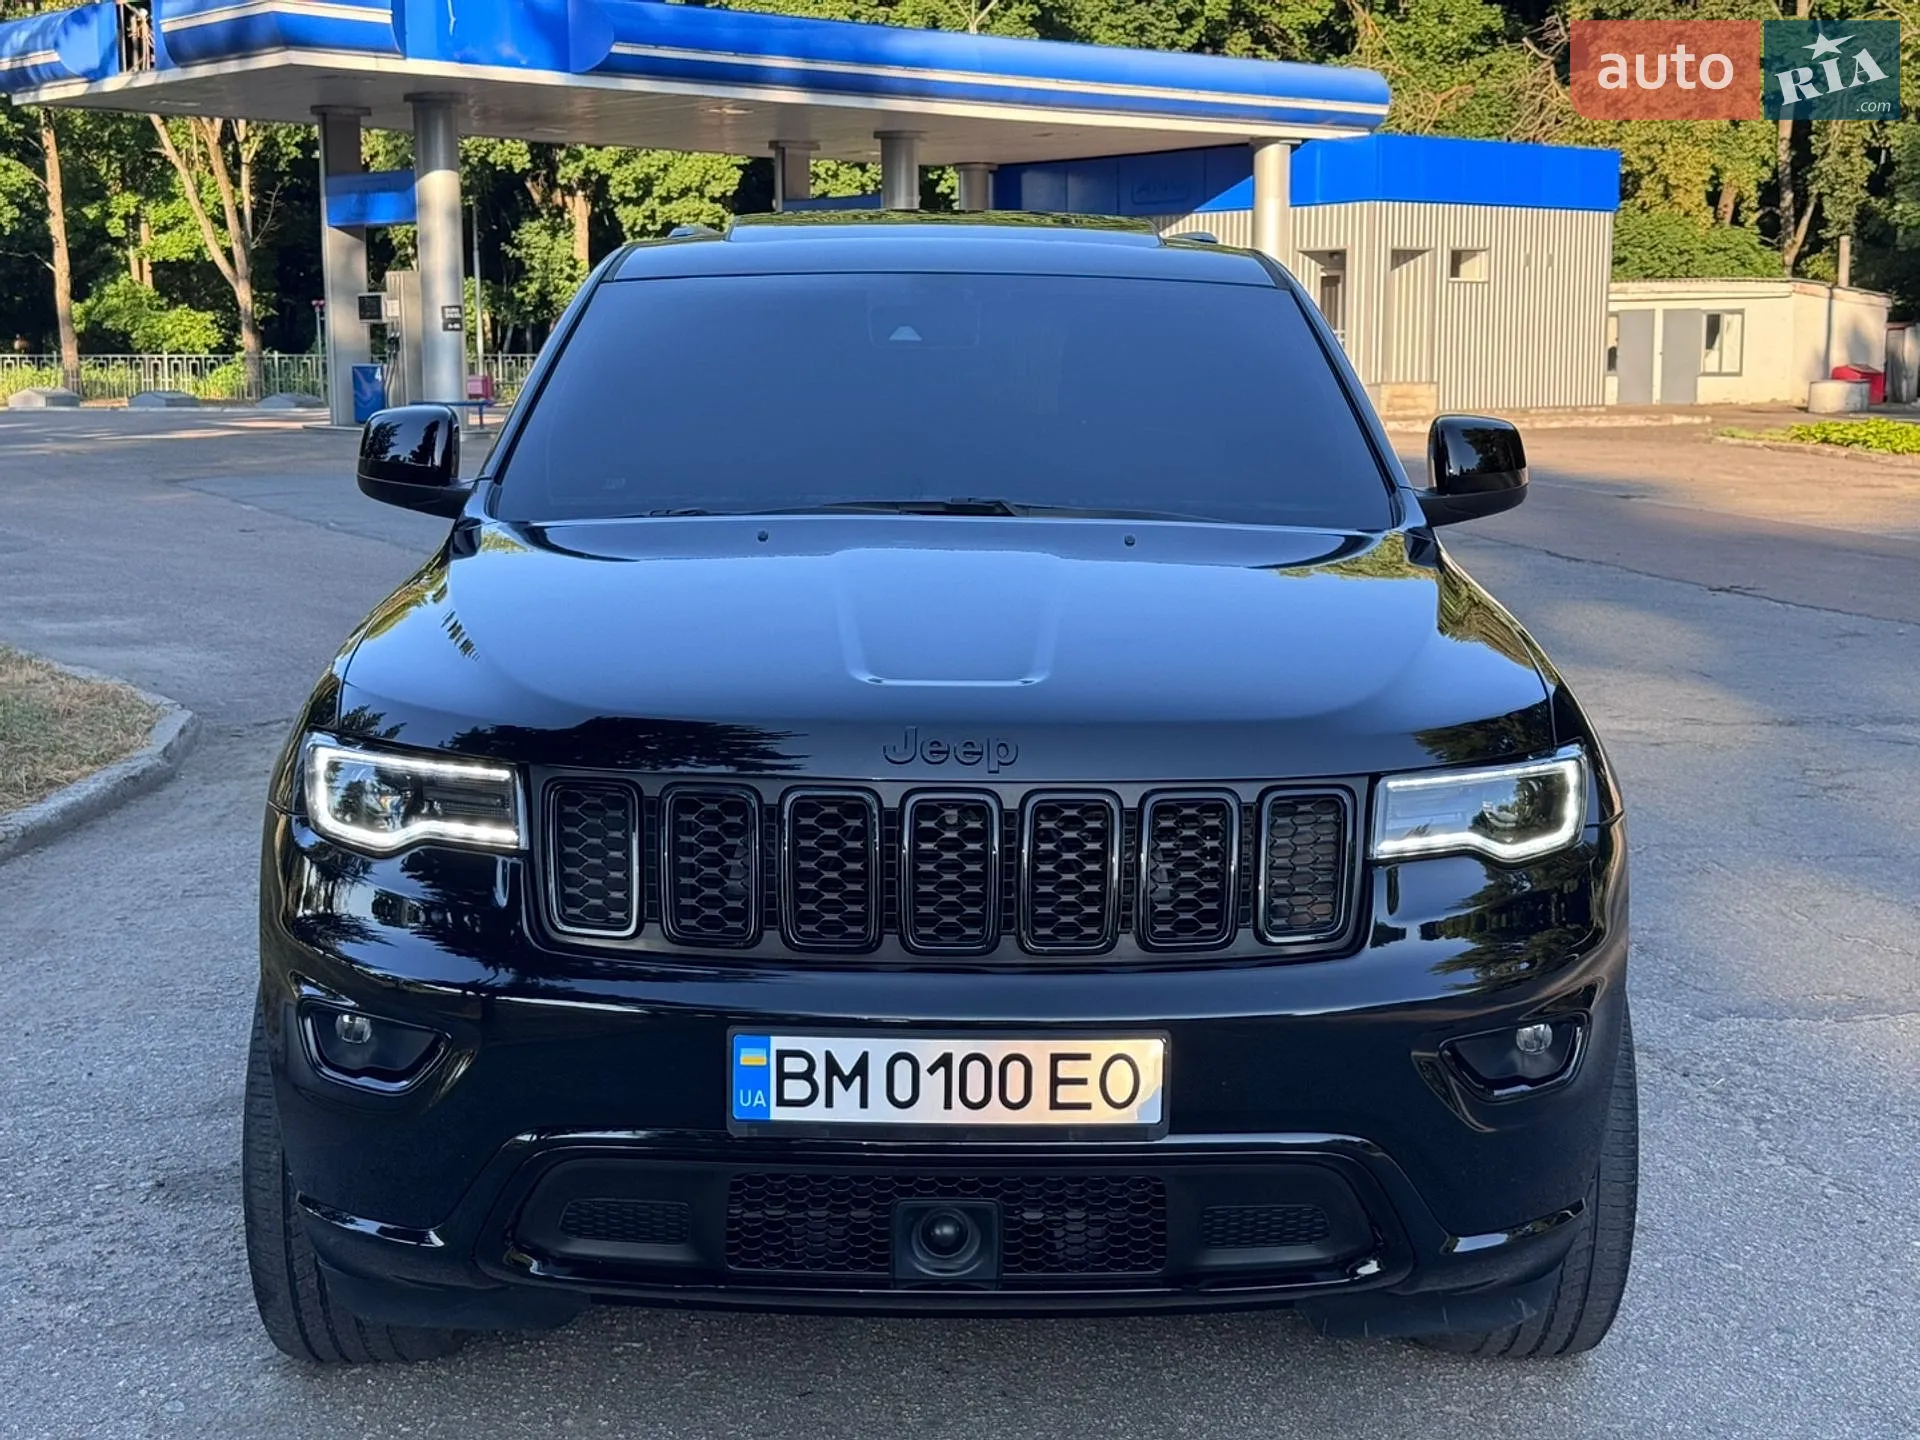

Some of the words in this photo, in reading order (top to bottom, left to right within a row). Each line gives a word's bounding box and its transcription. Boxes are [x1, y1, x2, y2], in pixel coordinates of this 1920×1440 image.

[883, 726, 1019, 774] Jeep
[739, 1088, 767, 1108] UA
[775, 1049, 870, 1109] BM
[885, 1051, 1034, 1110] 0100
[1049, 1053, 1141, 1111] EO
